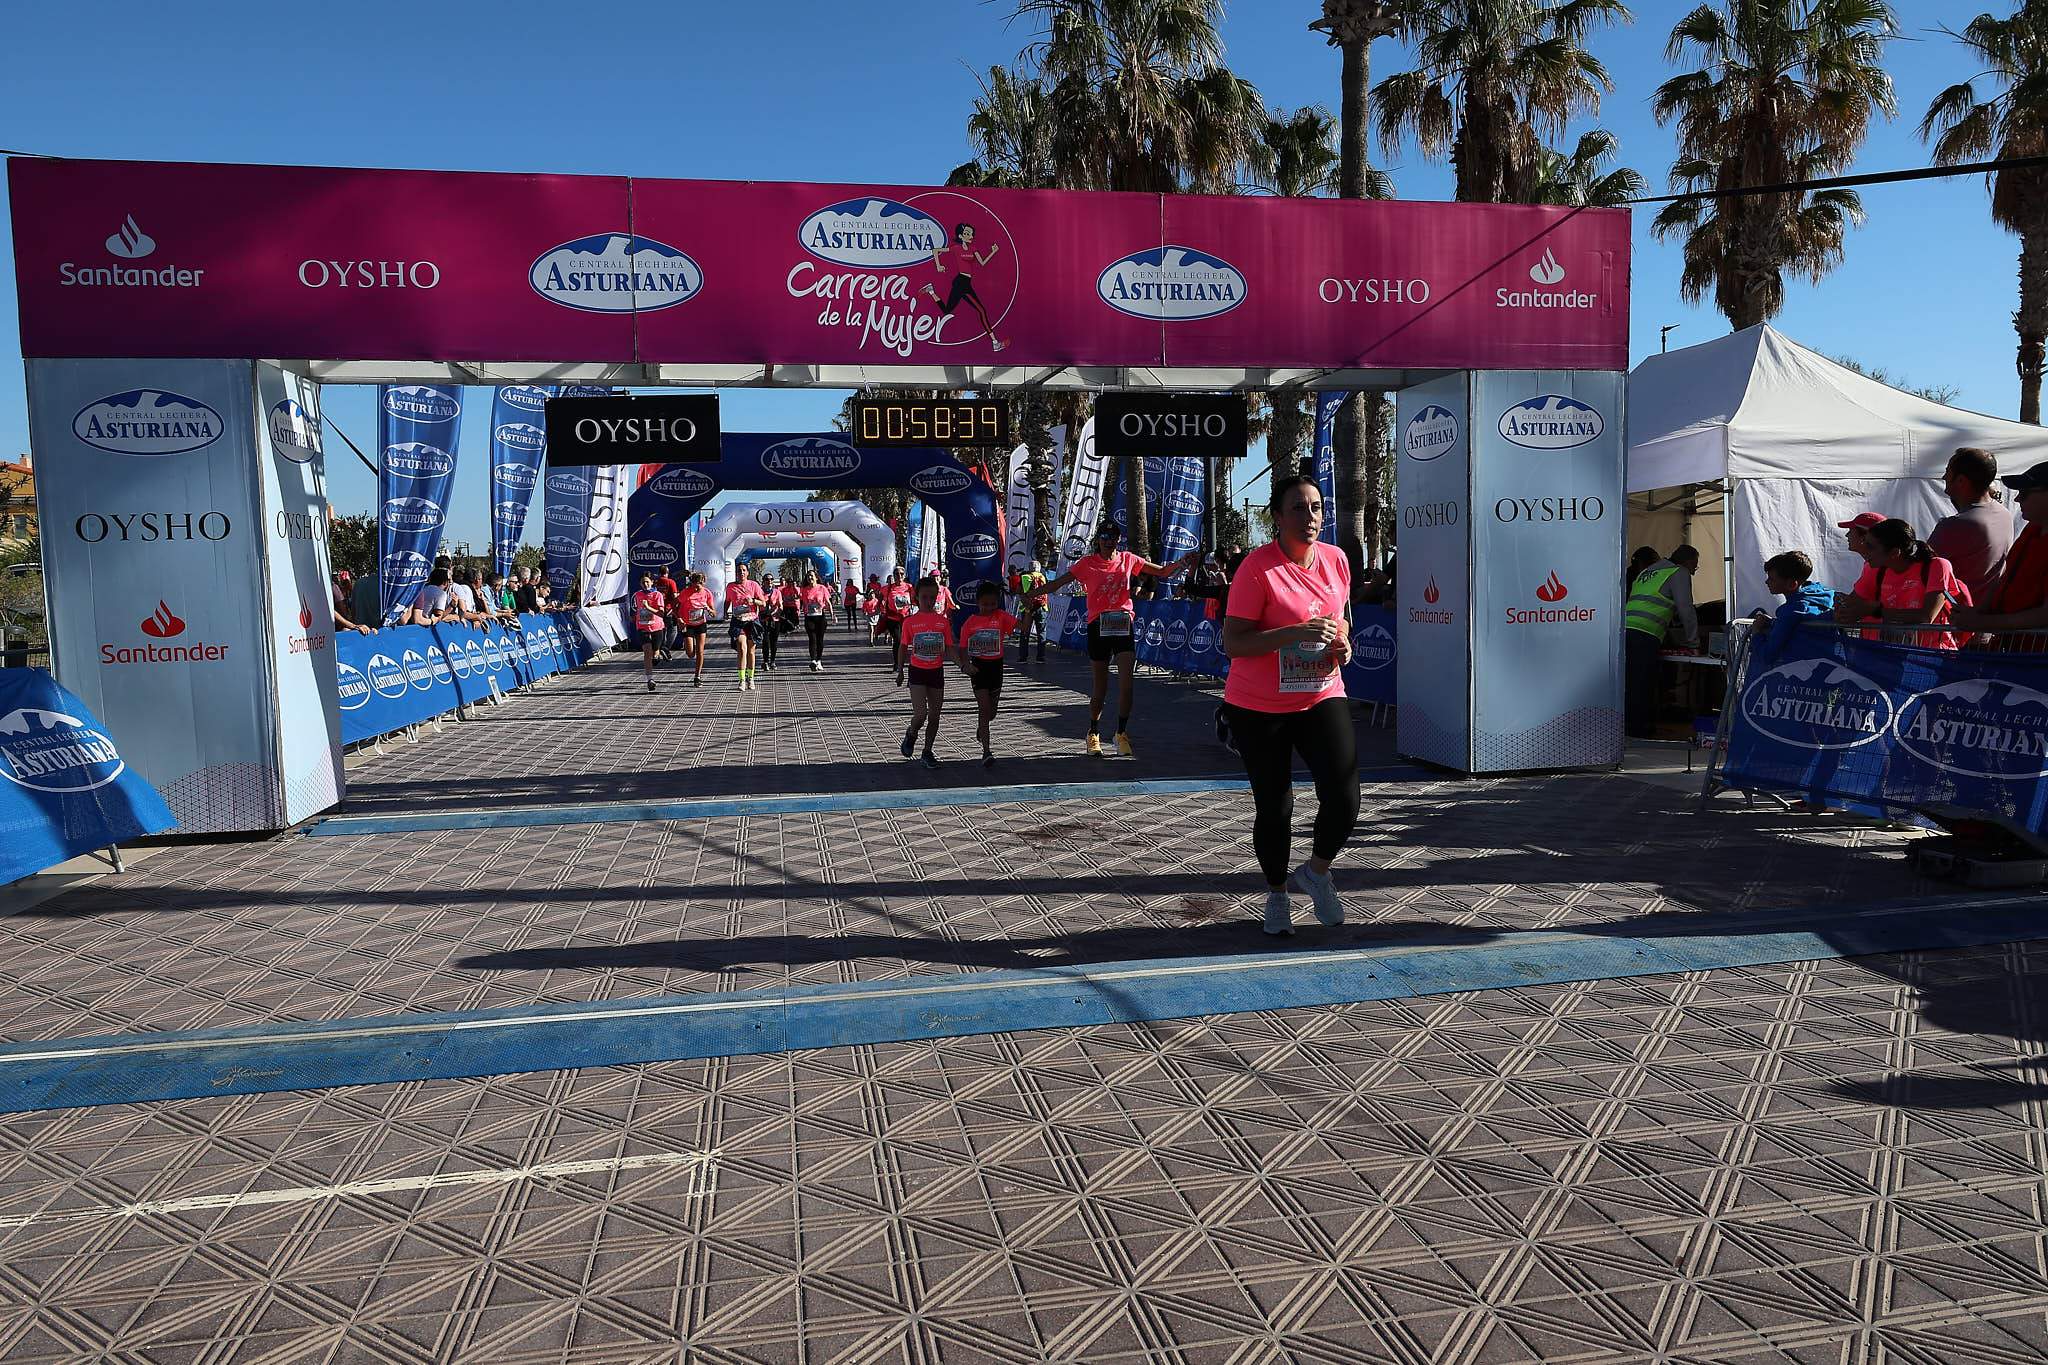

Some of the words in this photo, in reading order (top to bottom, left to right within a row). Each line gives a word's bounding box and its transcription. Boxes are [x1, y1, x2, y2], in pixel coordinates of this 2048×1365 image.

[811, 221, 936, 251] ASTURIANA
[832, 220, 880, 229] CENTRAL
[883, 221, 932, 231] LECHERA
[59, 262, 204, 288] Santander
[298, 258, 441, 289] OYSHO
[569, 259, 625, 269] CENTRAL
[1131, 270, 1179, 280] CENTRAL
[1183, 271, 1231, 280] LECHERA
[543, 261, 691, 292] ASTURIANA
[786, 261, 910, 301] Carrera
[1108, 272, 1237, 301] ASTURIANA
[1318, 278, 1430, 304] OYSHO
[1495, 287, 1597, 309] Santander
[817, 301, 841, 326] de
[845, 301, 863, 327] la
[858, 297, 956, 357] Mujer
[386, 394, 453, 416] ASTURIANA
[504, 389, 545, 408] ASTURIA
[84, 414, 214, 439] ASTURIANA
[106, 411, 155, 420] CENTRAL
[862, 407, 998, 439] 00:58:39
[1119, 413, 1227, 437] OYSHO
[1505, 415, 1598, 437] ASTURIANA
[1521, 413, 1557, 421] CENTRAL
[574, 417, 697, 444] OYSHO
[1407, 427, 1455, 451] ASTURIANA
[386, 451, 449, 472] ASTURIANA
[768, 449, 855, 469] ASTURIANA
[654, 478, 710, 492] ASTURIANA
[915, 476, 969, 489] ASTURIANA
[755, 507, 835, 525] OYSHO
[1404, 500, 1459, 529] OYSHO
[1494, 496, 1605, 523] OYSHO
[75, 511, 231, 543] OYSHO
[277, 510, 323, 542] OYSHO
[631, 550, 675, 561] ASTURIANA
[1408, 607, 1454, 625] Santander
[1505, 605, 1597, 625] Santander
[100, 642, 229, 665] Santander
[288, 630, 327, 655] Santander
[1777, 684, 1823, 698] CENTRAL
[1751, 684, 1878, 733] ASTURIANA
[1903, 703, 2048, 757] ASTURIAN
[12, 735, 57, 750] CENTRAL
[1, 743, 120, 779] ASTURIANA
